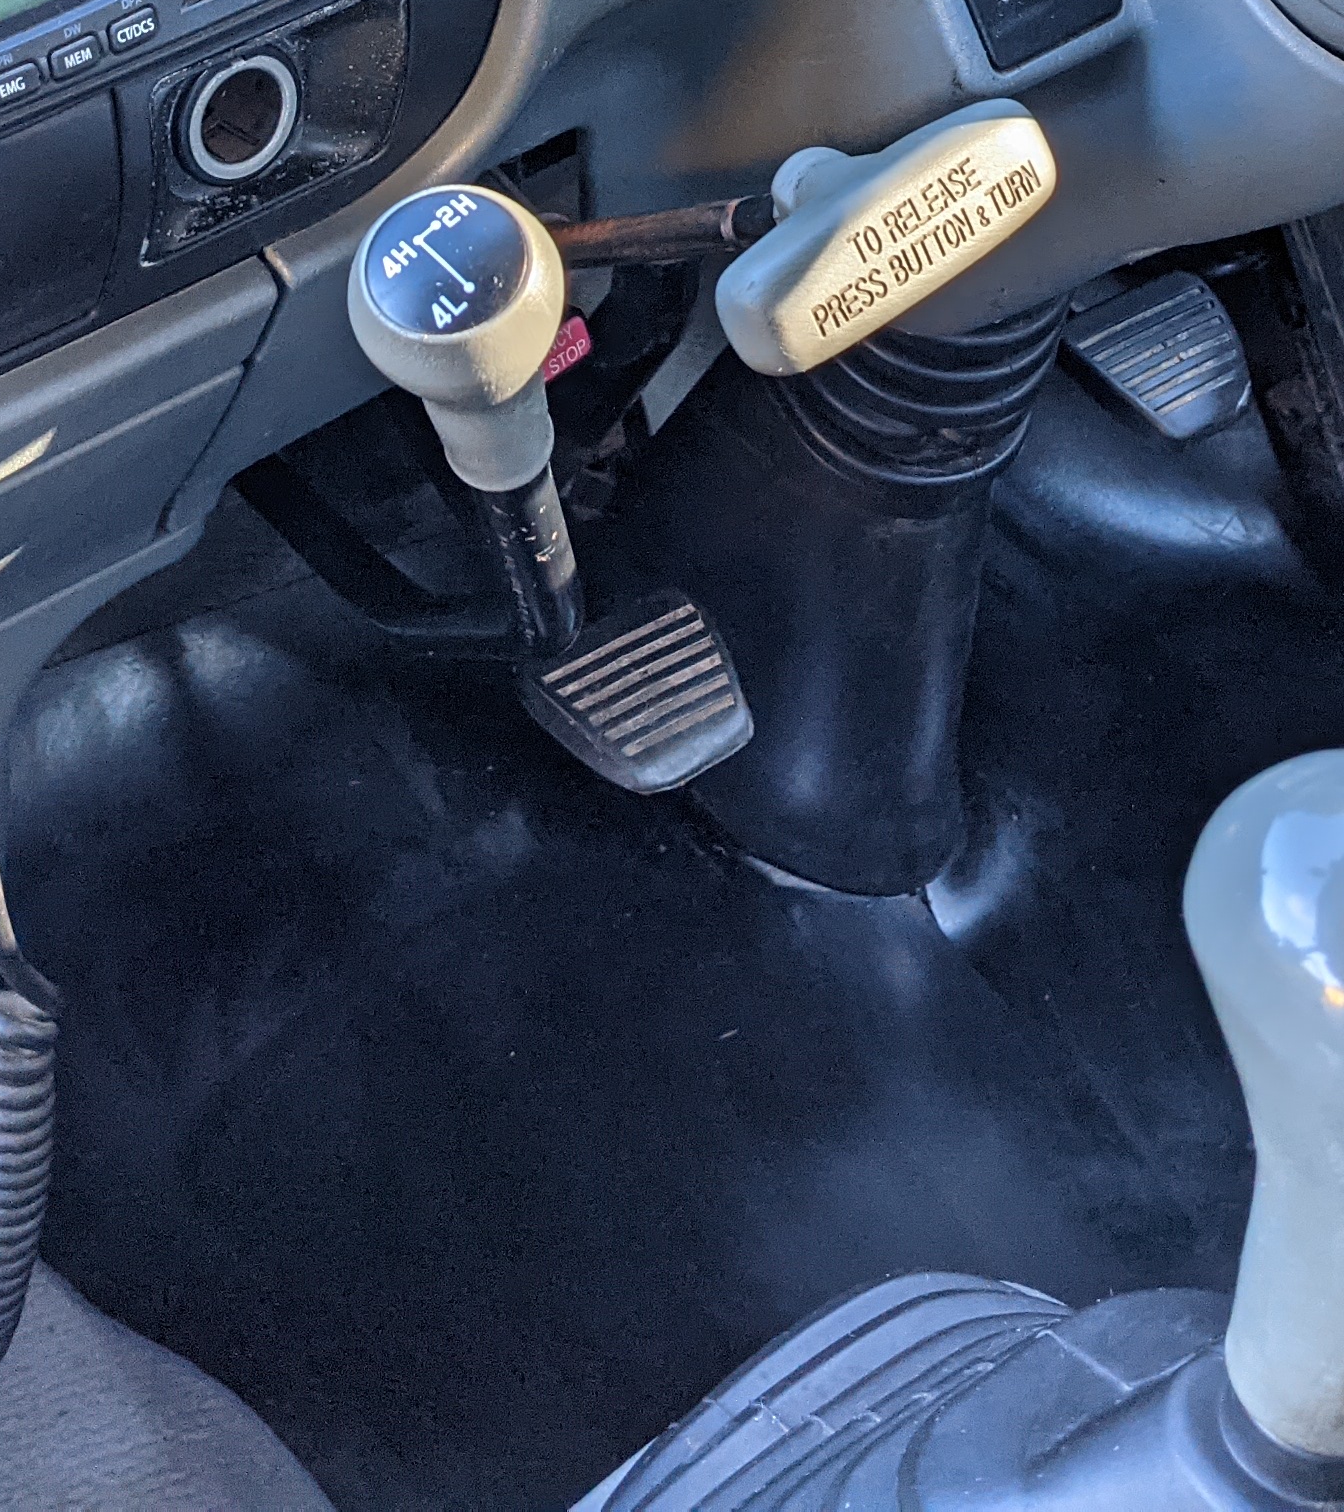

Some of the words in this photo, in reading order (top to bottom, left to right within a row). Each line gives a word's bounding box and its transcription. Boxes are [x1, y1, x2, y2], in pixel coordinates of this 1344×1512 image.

[62, 22, 83, 40] DW
[116, 17, 156, 45] CT/DCS
[62, 46, 94, 70] MEM
[434, 193, 478, 229] 2H
[846, 225, 883, 265] TO
[881, 157, 983, 244] RELEASE
[381, 240, 419, 280] 4H
[810, 268, 888, 339] PRESS
[888, 208, 976, 287] BUTTON
[976, 204, 991, 228] &
[984, 159, 1043, 217] TURN
[430, 294, 469, 329] 4L
[548, 338, 586, 374] STOP
